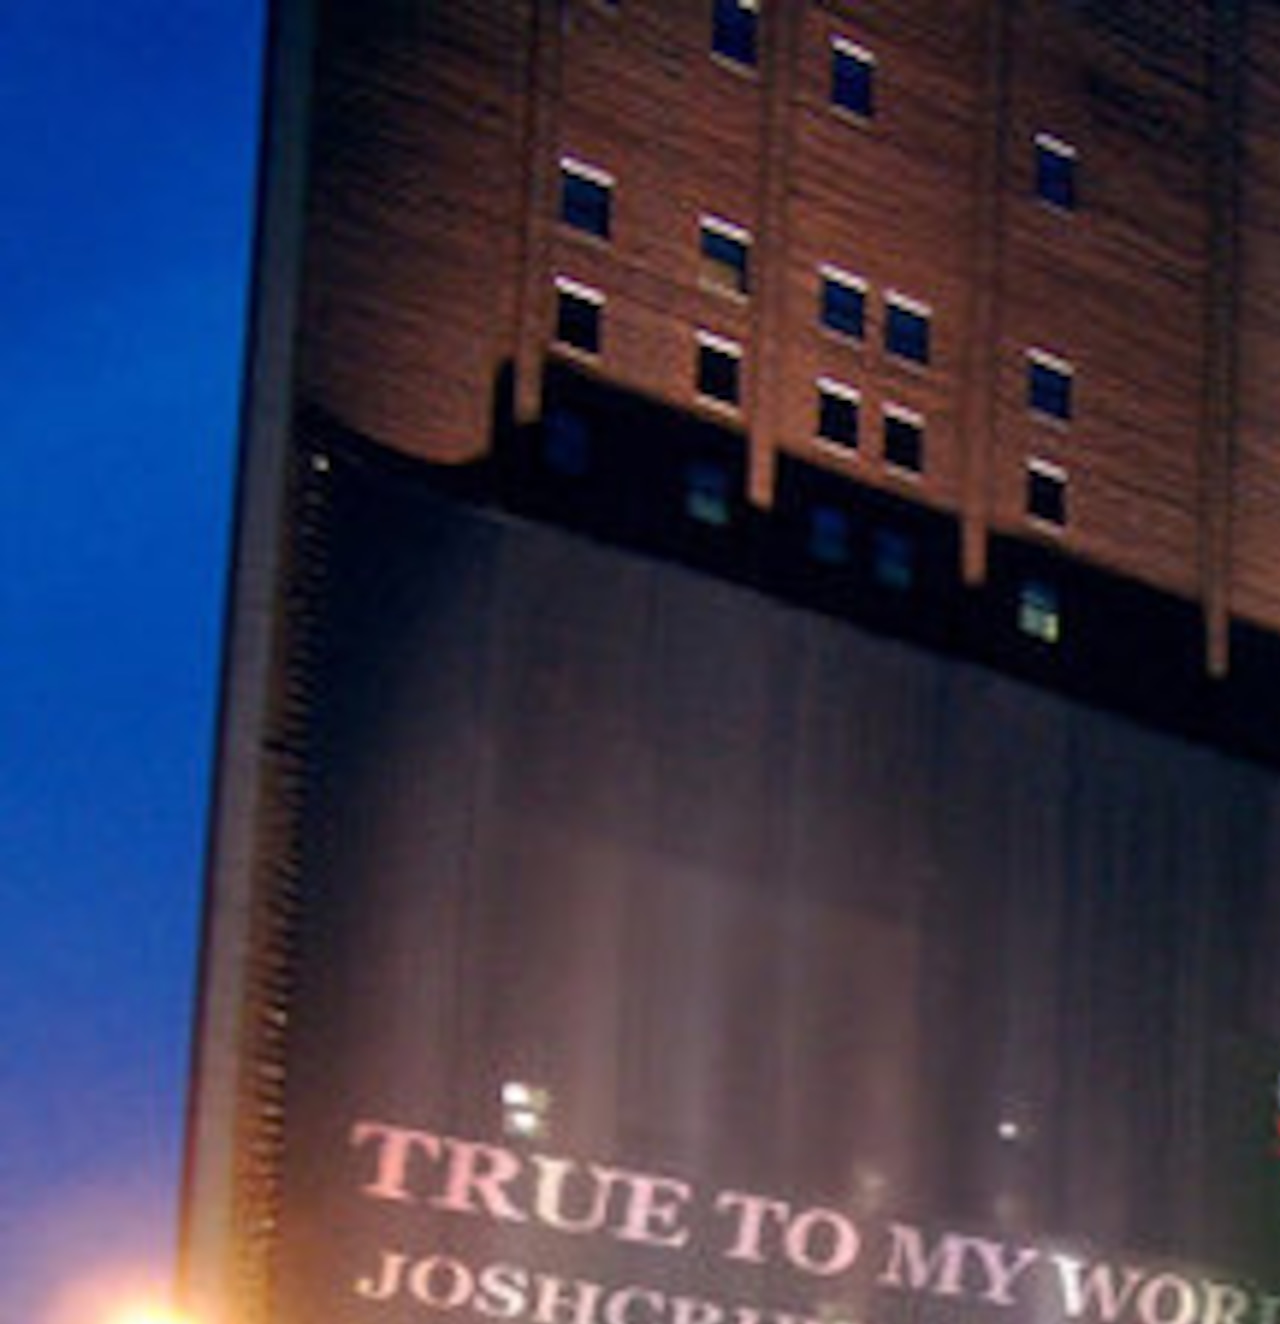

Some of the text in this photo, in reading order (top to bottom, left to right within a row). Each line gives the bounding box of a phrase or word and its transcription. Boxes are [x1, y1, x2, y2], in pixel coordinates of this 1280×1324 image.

[351, 1121, 691, 1249] TRUE
[714, 1191, 861, 1276] TO
[878, 1224, 1039, 1306] MY
